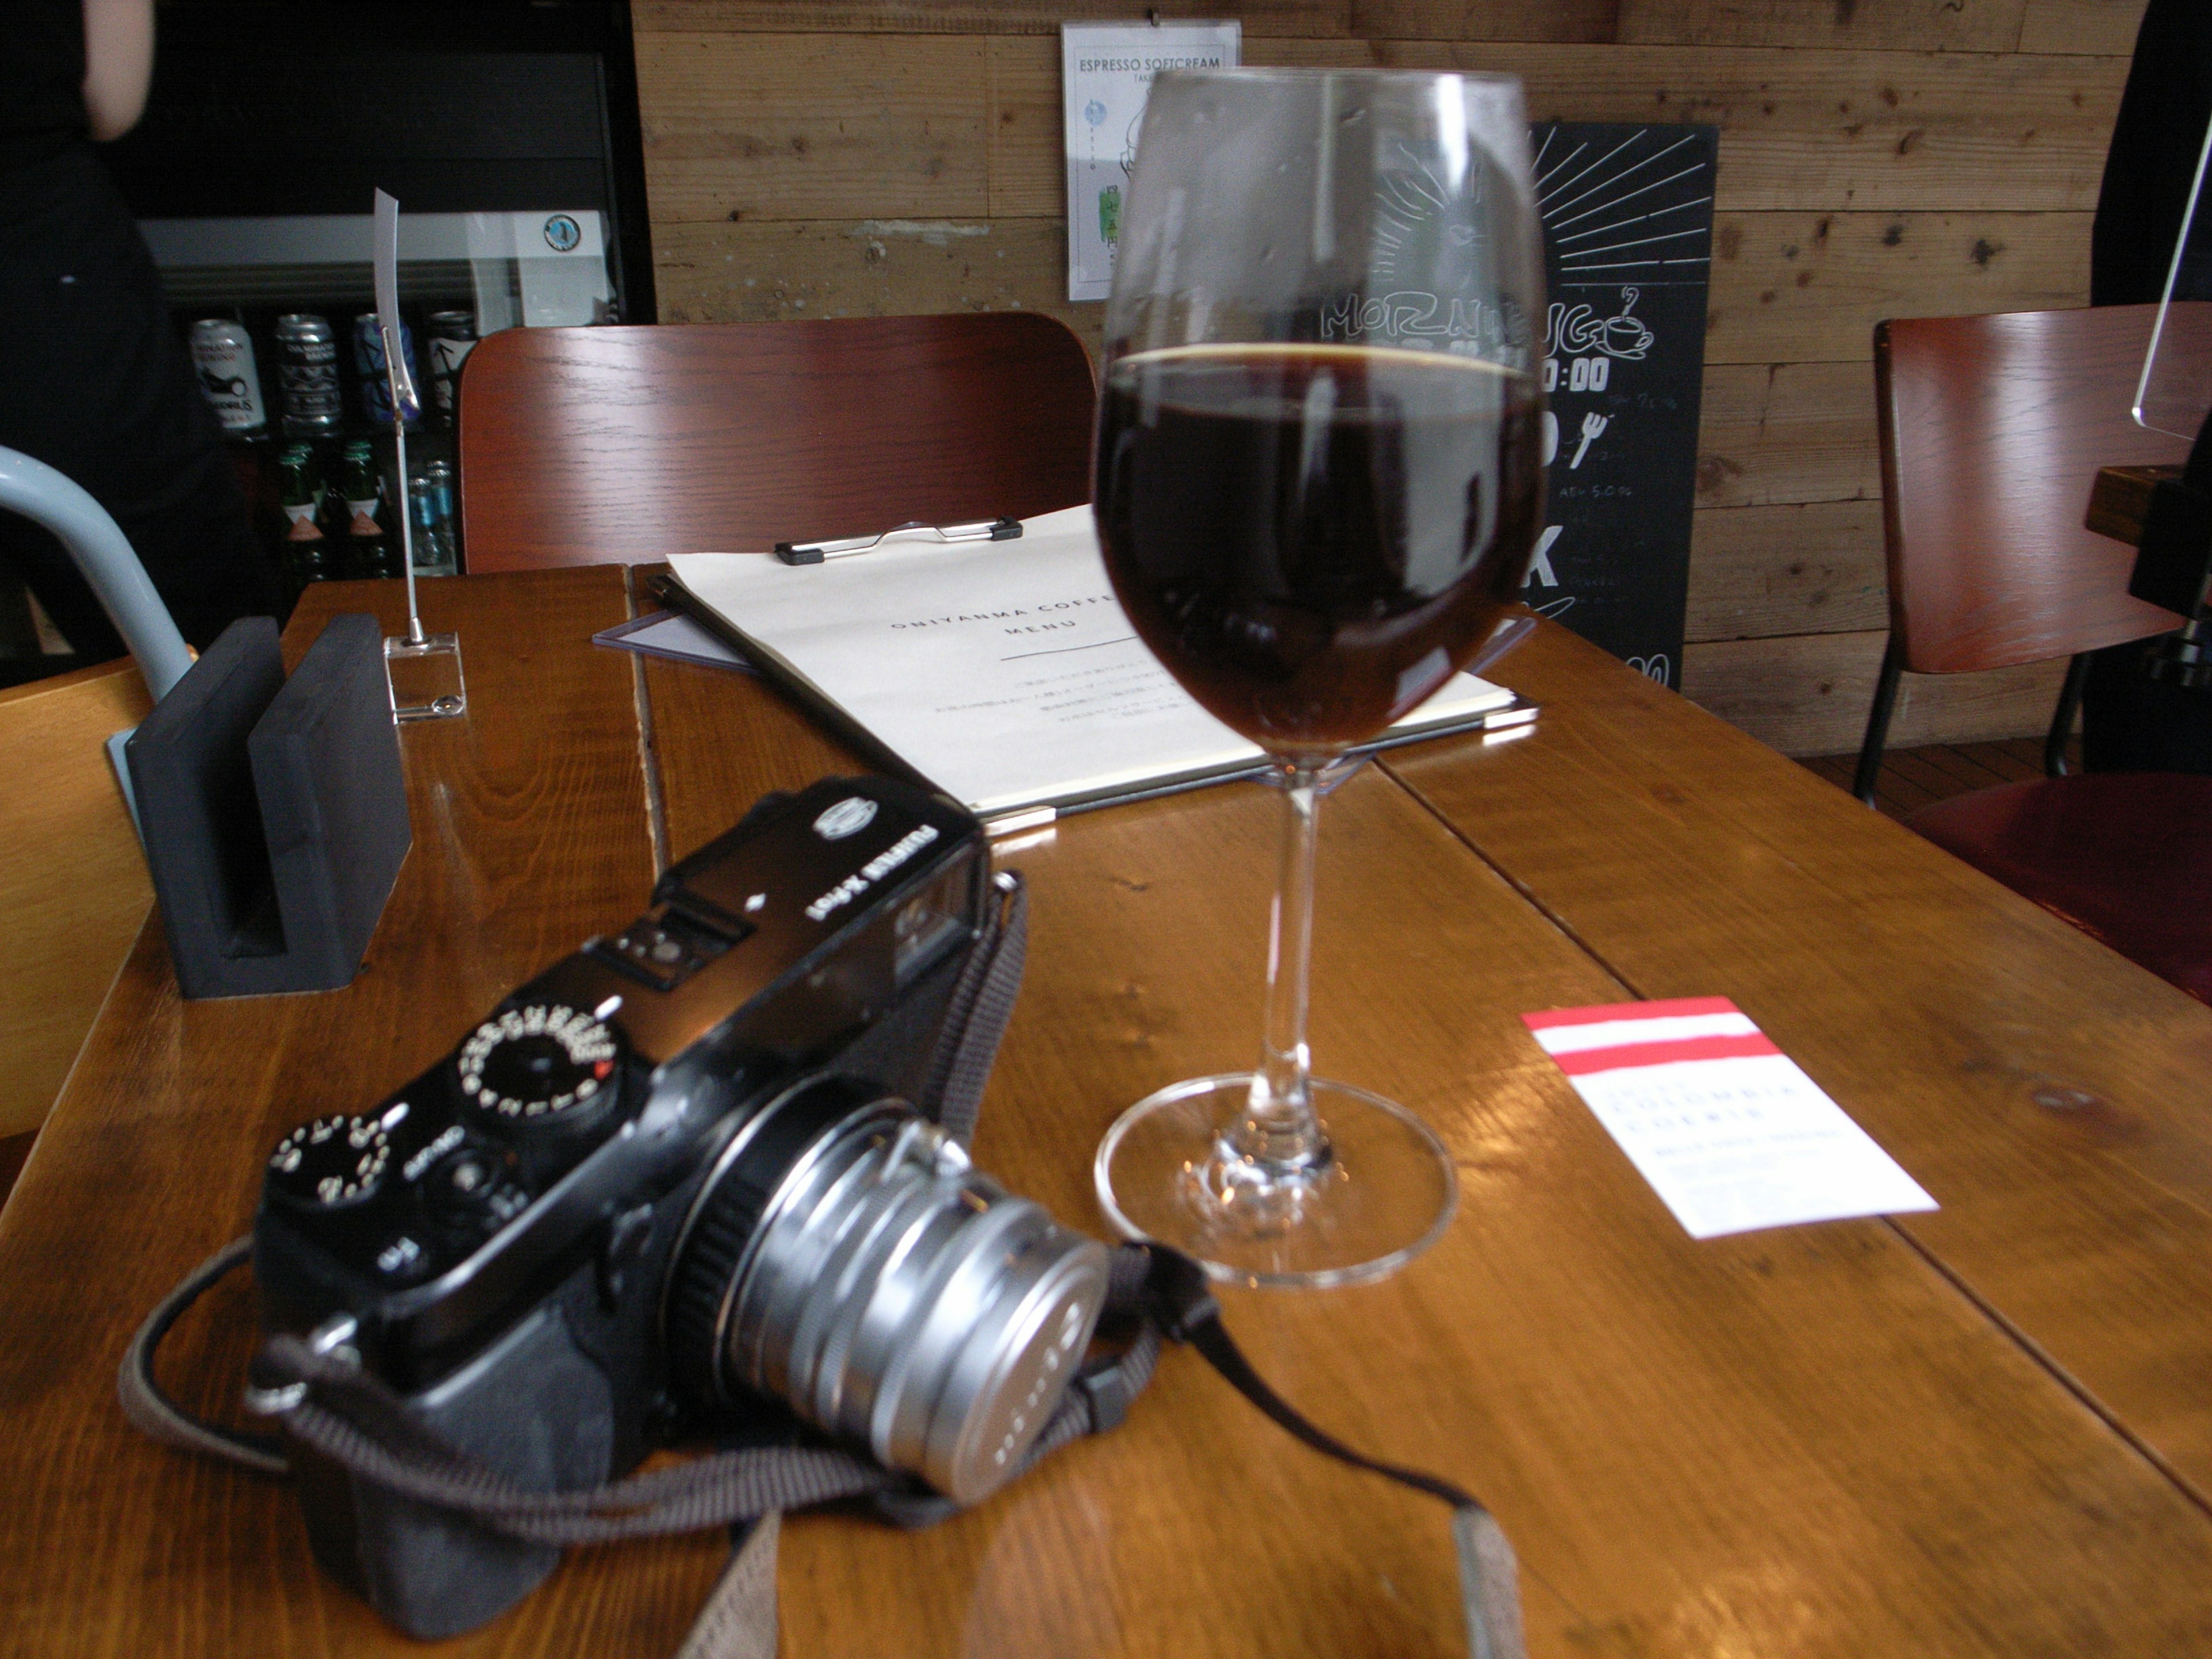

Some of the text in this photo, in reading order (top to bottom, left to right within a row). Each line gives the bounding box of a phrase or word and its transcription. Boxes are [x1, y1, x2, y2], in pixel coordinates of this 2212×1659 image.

[1080, 57, 1219, 72] ESPRESSO SOFTCREAM
[891, 608, 1029, 630] ONIYANMA
[1005, 619, 1077, 635] MENU
